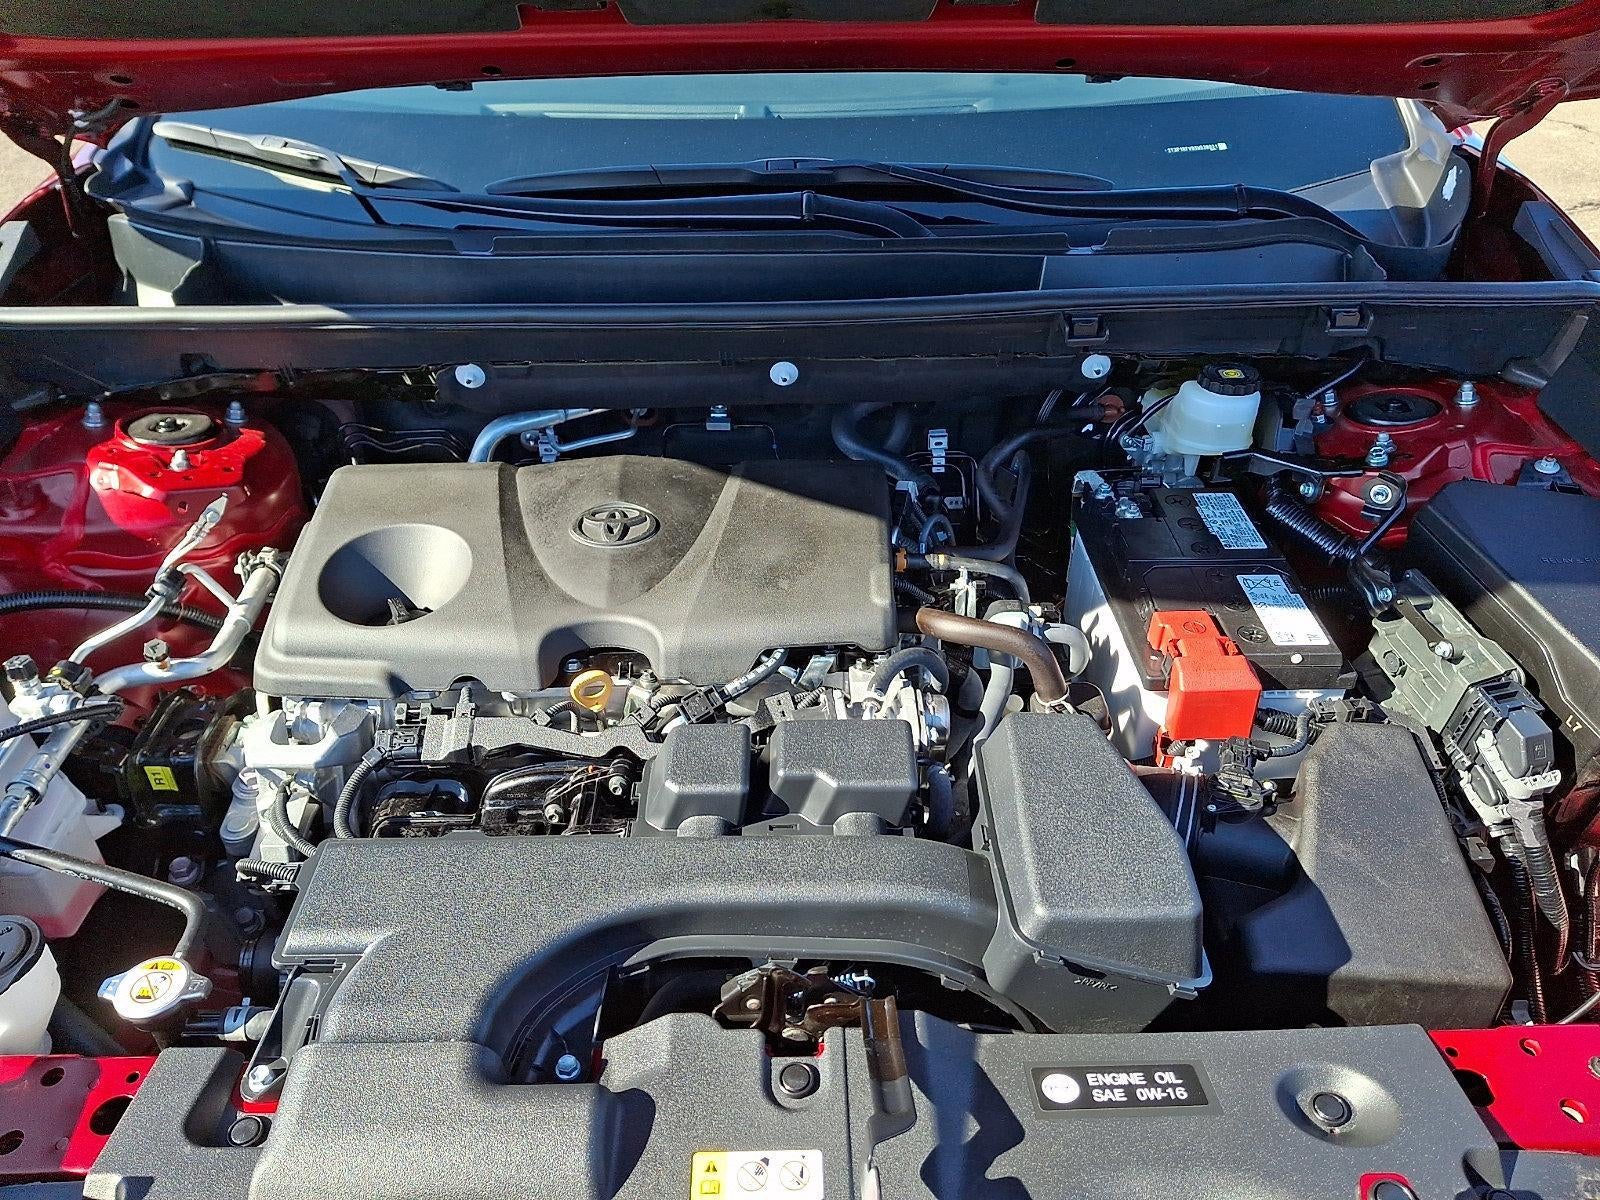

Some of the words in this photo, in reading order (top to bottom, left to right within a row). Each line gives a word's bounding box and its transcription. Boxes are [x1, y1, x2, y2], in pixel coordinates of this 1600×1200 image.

[1566, 714, 1583, 732] L7
[151, 772, 166, 785] R1
[1085, 1072, 1148, 1087] ENGINE
[1153, 1071, 1184, 1086] OIL
[1091, 1088, 1128, 1103] SAE
[1135, 1086, 1189, 1102] 0W-16
